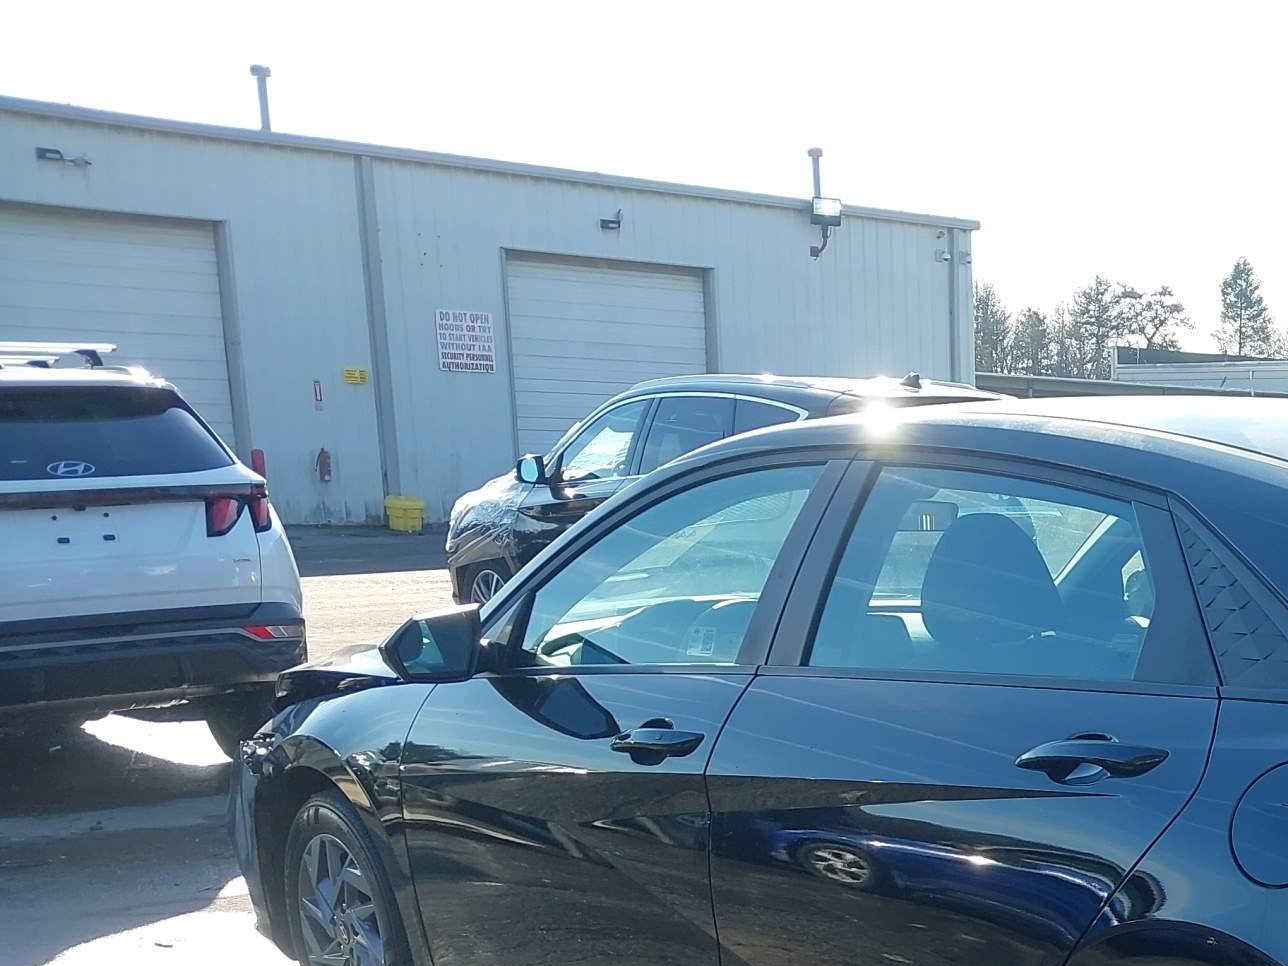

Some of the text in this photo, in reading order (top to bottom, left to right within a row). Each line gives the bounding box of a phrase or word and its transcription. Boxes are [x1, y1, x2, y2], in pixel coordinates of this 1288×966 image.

[440, 311, 490, 324] DO NOT OPEN
[439, 322, 464, 332] HOODS
[478, 325, 491, 333] TRY
[439, 332, 493, 343] TO START VEHICLES
[440, 341, 492, 352] WITHOUT IAA
[441, 351, 494, 362] SECURITY PERSONNEL
[442, 360, 494, 371] AUTHORIZATION
